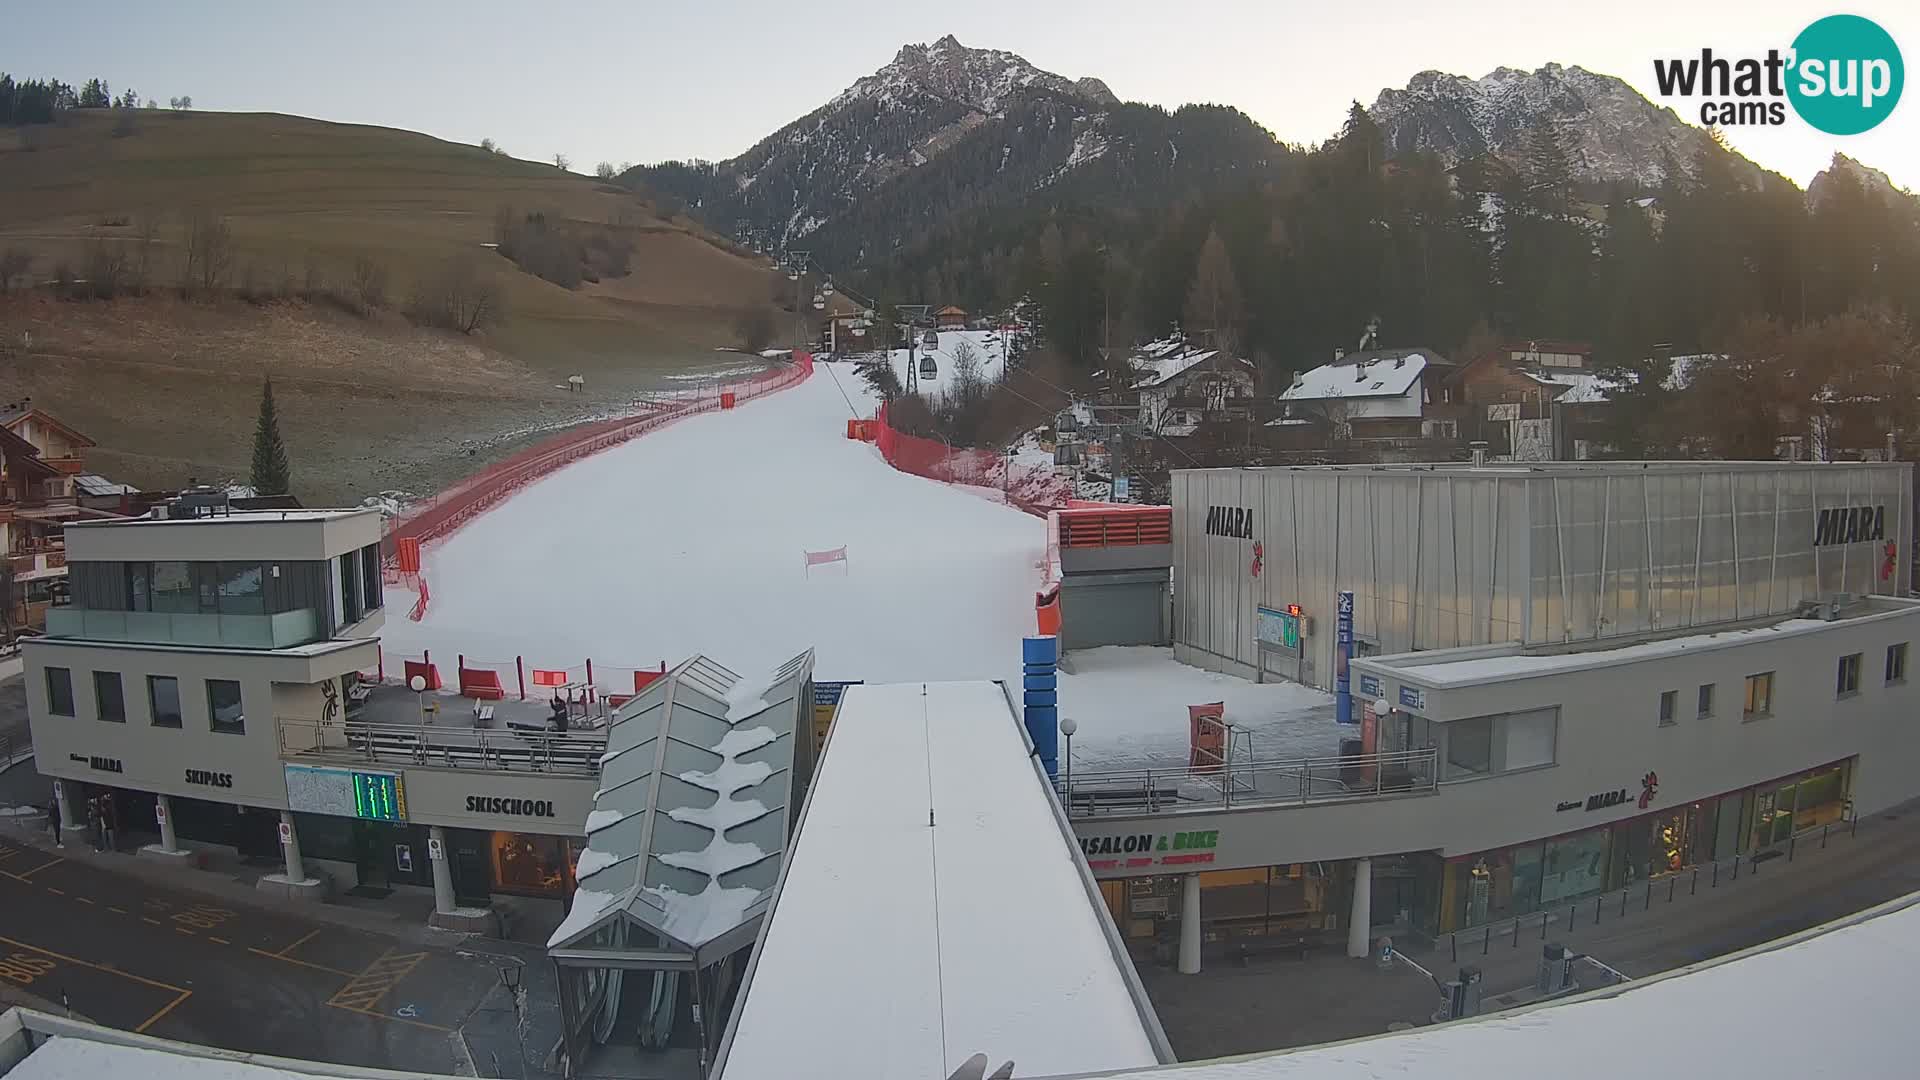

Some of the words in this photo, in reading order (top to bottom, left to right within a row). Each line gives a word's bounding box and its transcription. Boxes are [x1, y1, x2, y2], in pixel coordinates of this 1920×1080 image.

[1206, 505, 1253, 540] MIARA
[1814, 505, 1884, 546] MIARA
[90, 756, 123, 774] MIARA
[185, 769, 232, 788] SKIPASS
[466, 796, 555, 817] SKISCHOOL
[1585, 789, 1626, 812] MIARA
[1078, 835, 1153, 855] ISALON
[1173, 831, 1218, 850] BIKE
[0, 953, 56, 983] BUS
